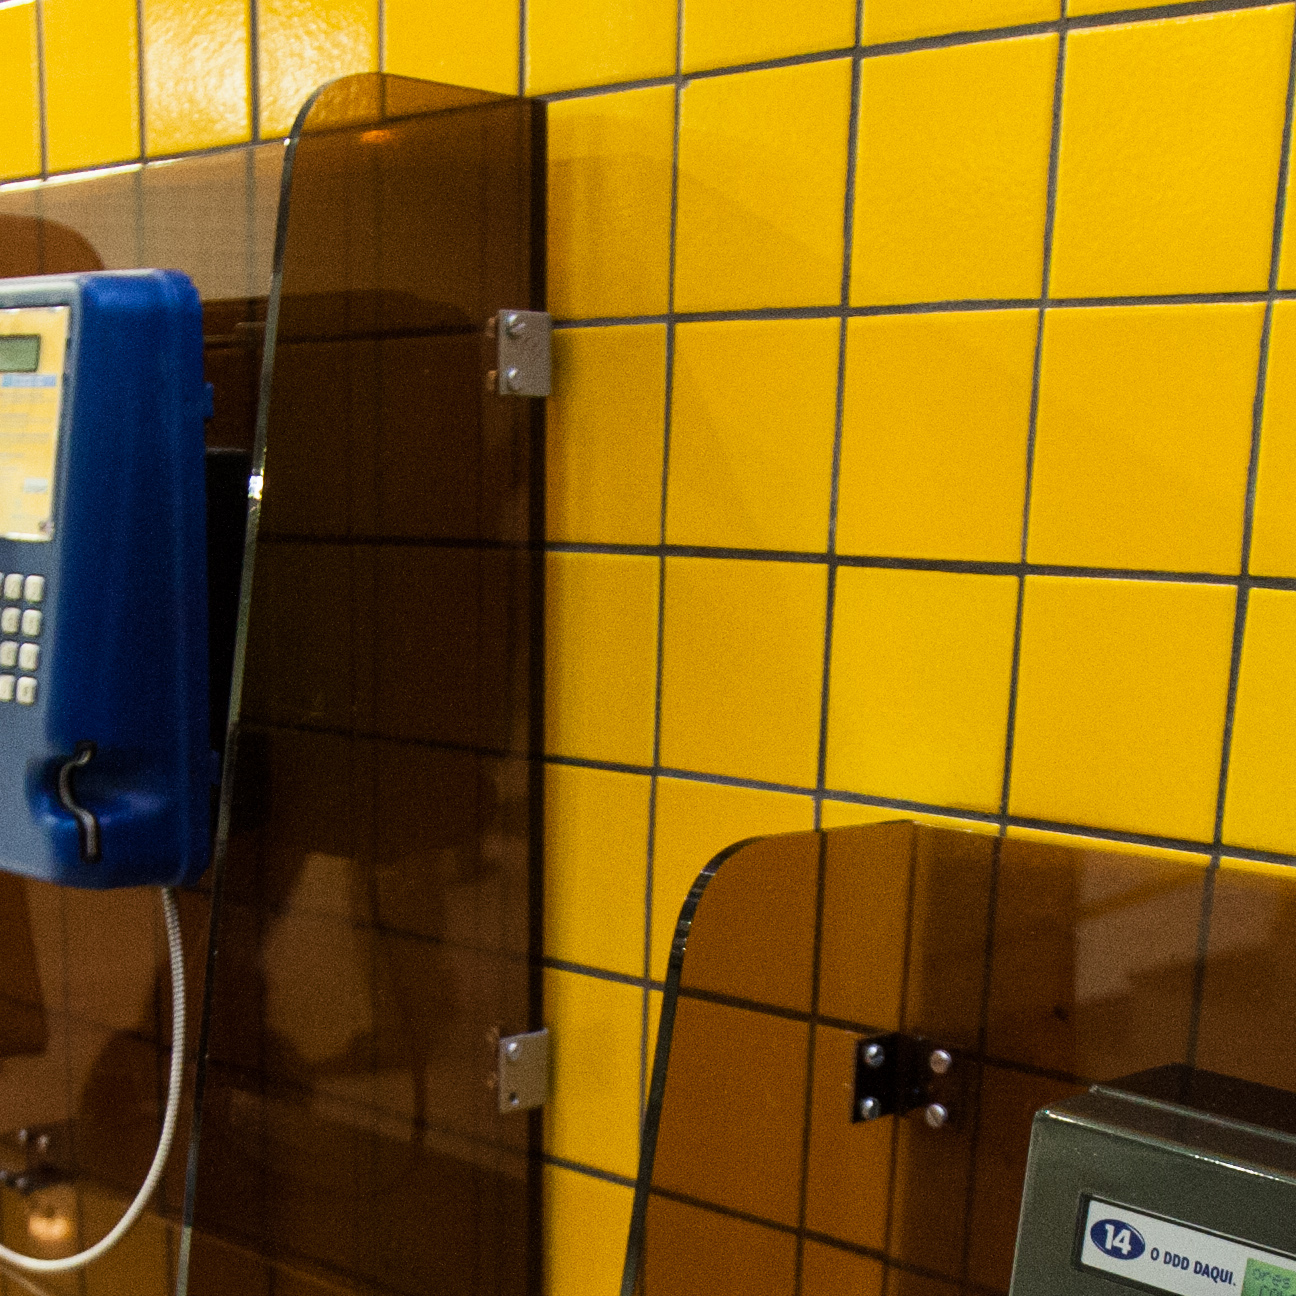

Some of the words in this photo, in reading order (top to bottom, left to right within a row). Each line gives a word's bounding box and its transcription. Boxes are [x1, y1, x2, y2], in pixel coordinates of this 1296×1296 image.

[1104, 1224, 1132, 1255] 14
[1150, 1247, 1160, 1261] O
[1163, 1251, 1190, 1270] DDD
[1193, 1260, 1236, 1286] DAQUI.
